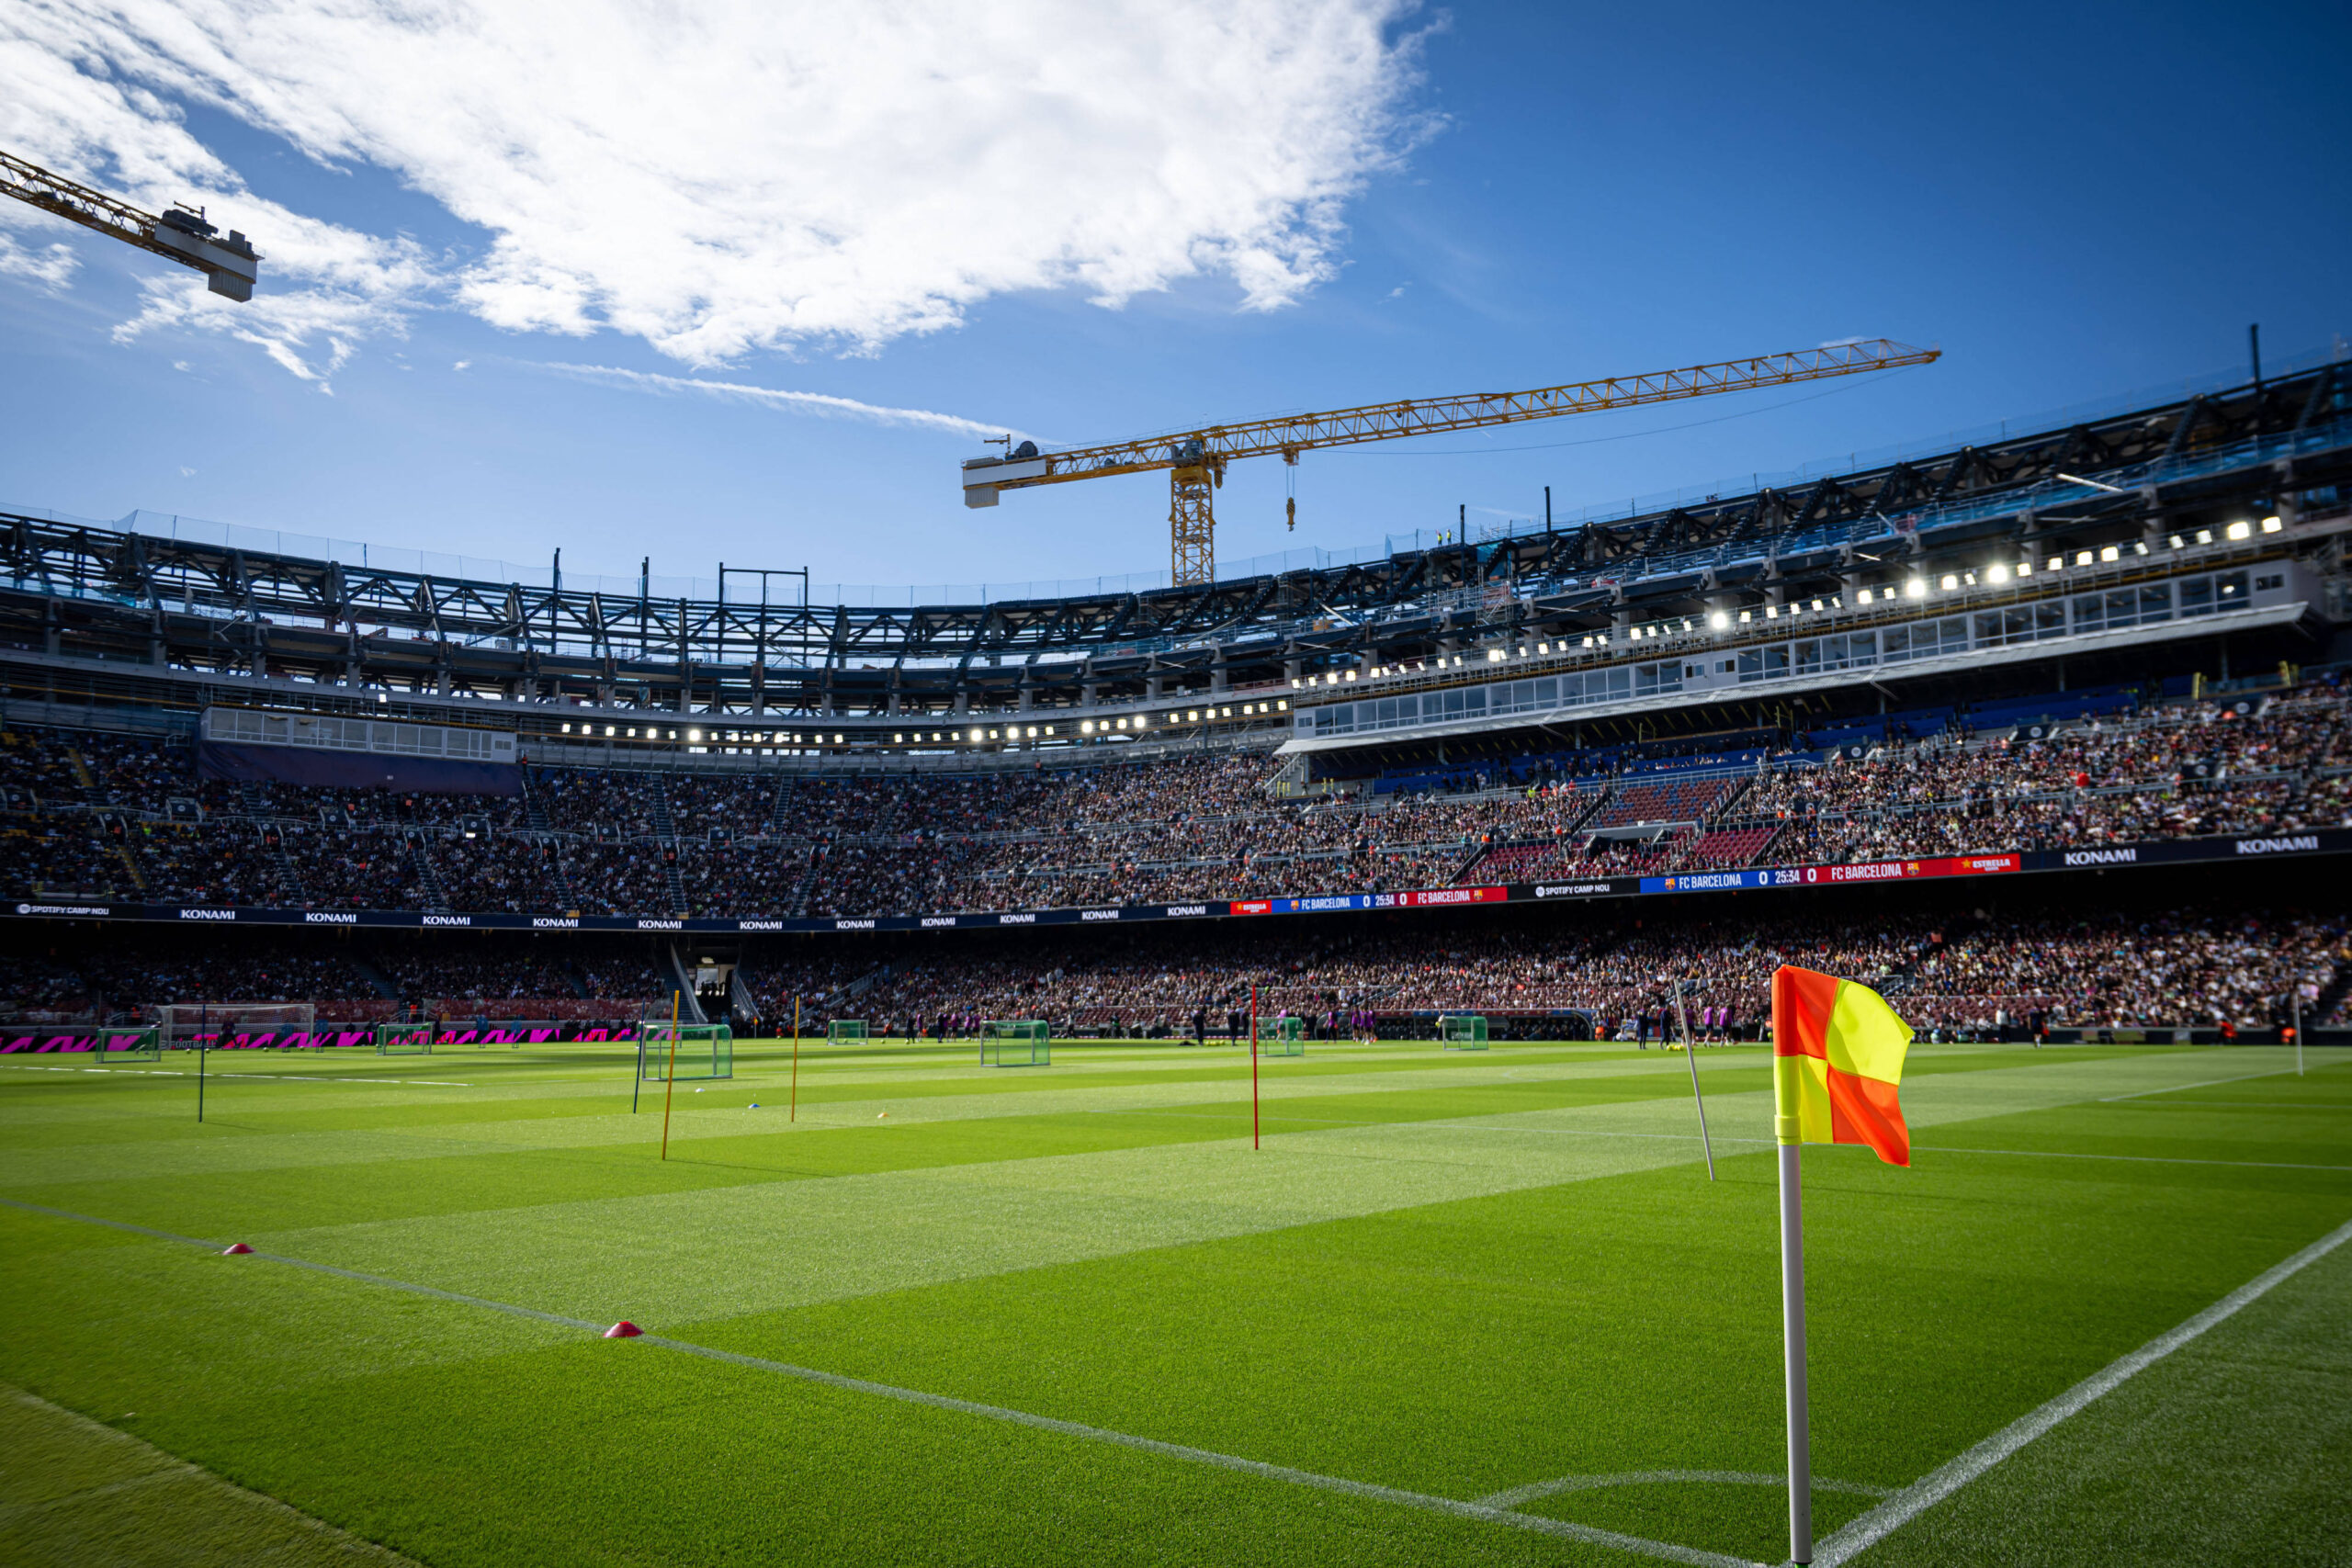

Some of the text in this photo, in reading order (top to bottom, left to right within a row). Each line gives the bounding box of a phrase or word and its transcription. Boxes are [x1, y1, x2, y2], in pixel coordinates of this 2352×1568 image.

[2236, 835, 2319, 854] KONAMI
[2065, 848, 2136, 865] KONAMI
[1973, 858, 2011, 868] ESTRELLA
[1679, 863, 1903, 889] FC BARCELONA 0 25:34 0 FC BARCELONA
[1546, 887, 1574, 896] SPOTIFY
[1574, 886, 1593, 894] CAMP
[1302, 890, 1470, 909] FC BARCELONA 0 25:34 0 FC BARCELONA
[30, 905, 66, 914] SPOTIFY
[182, 909, 235, 920] KONAMI
[1082, 910, 1118, 919] KONAMI
[1168, 906, 1206, 916] KONAMI
[307, 913, 356, 923] KONAMI
[424, 916, 469, 926] KONAMI
[922, 918, 956, 927] KONAMI
[1001, 914, 1035, 923] KONAMI
[534, 919, 579, 928] KONAMI
[639, 920, 683, 929] KONAMI
[741, 921, 783, 930] KONAMI
[837, 920, 875, 929] KONAMI
